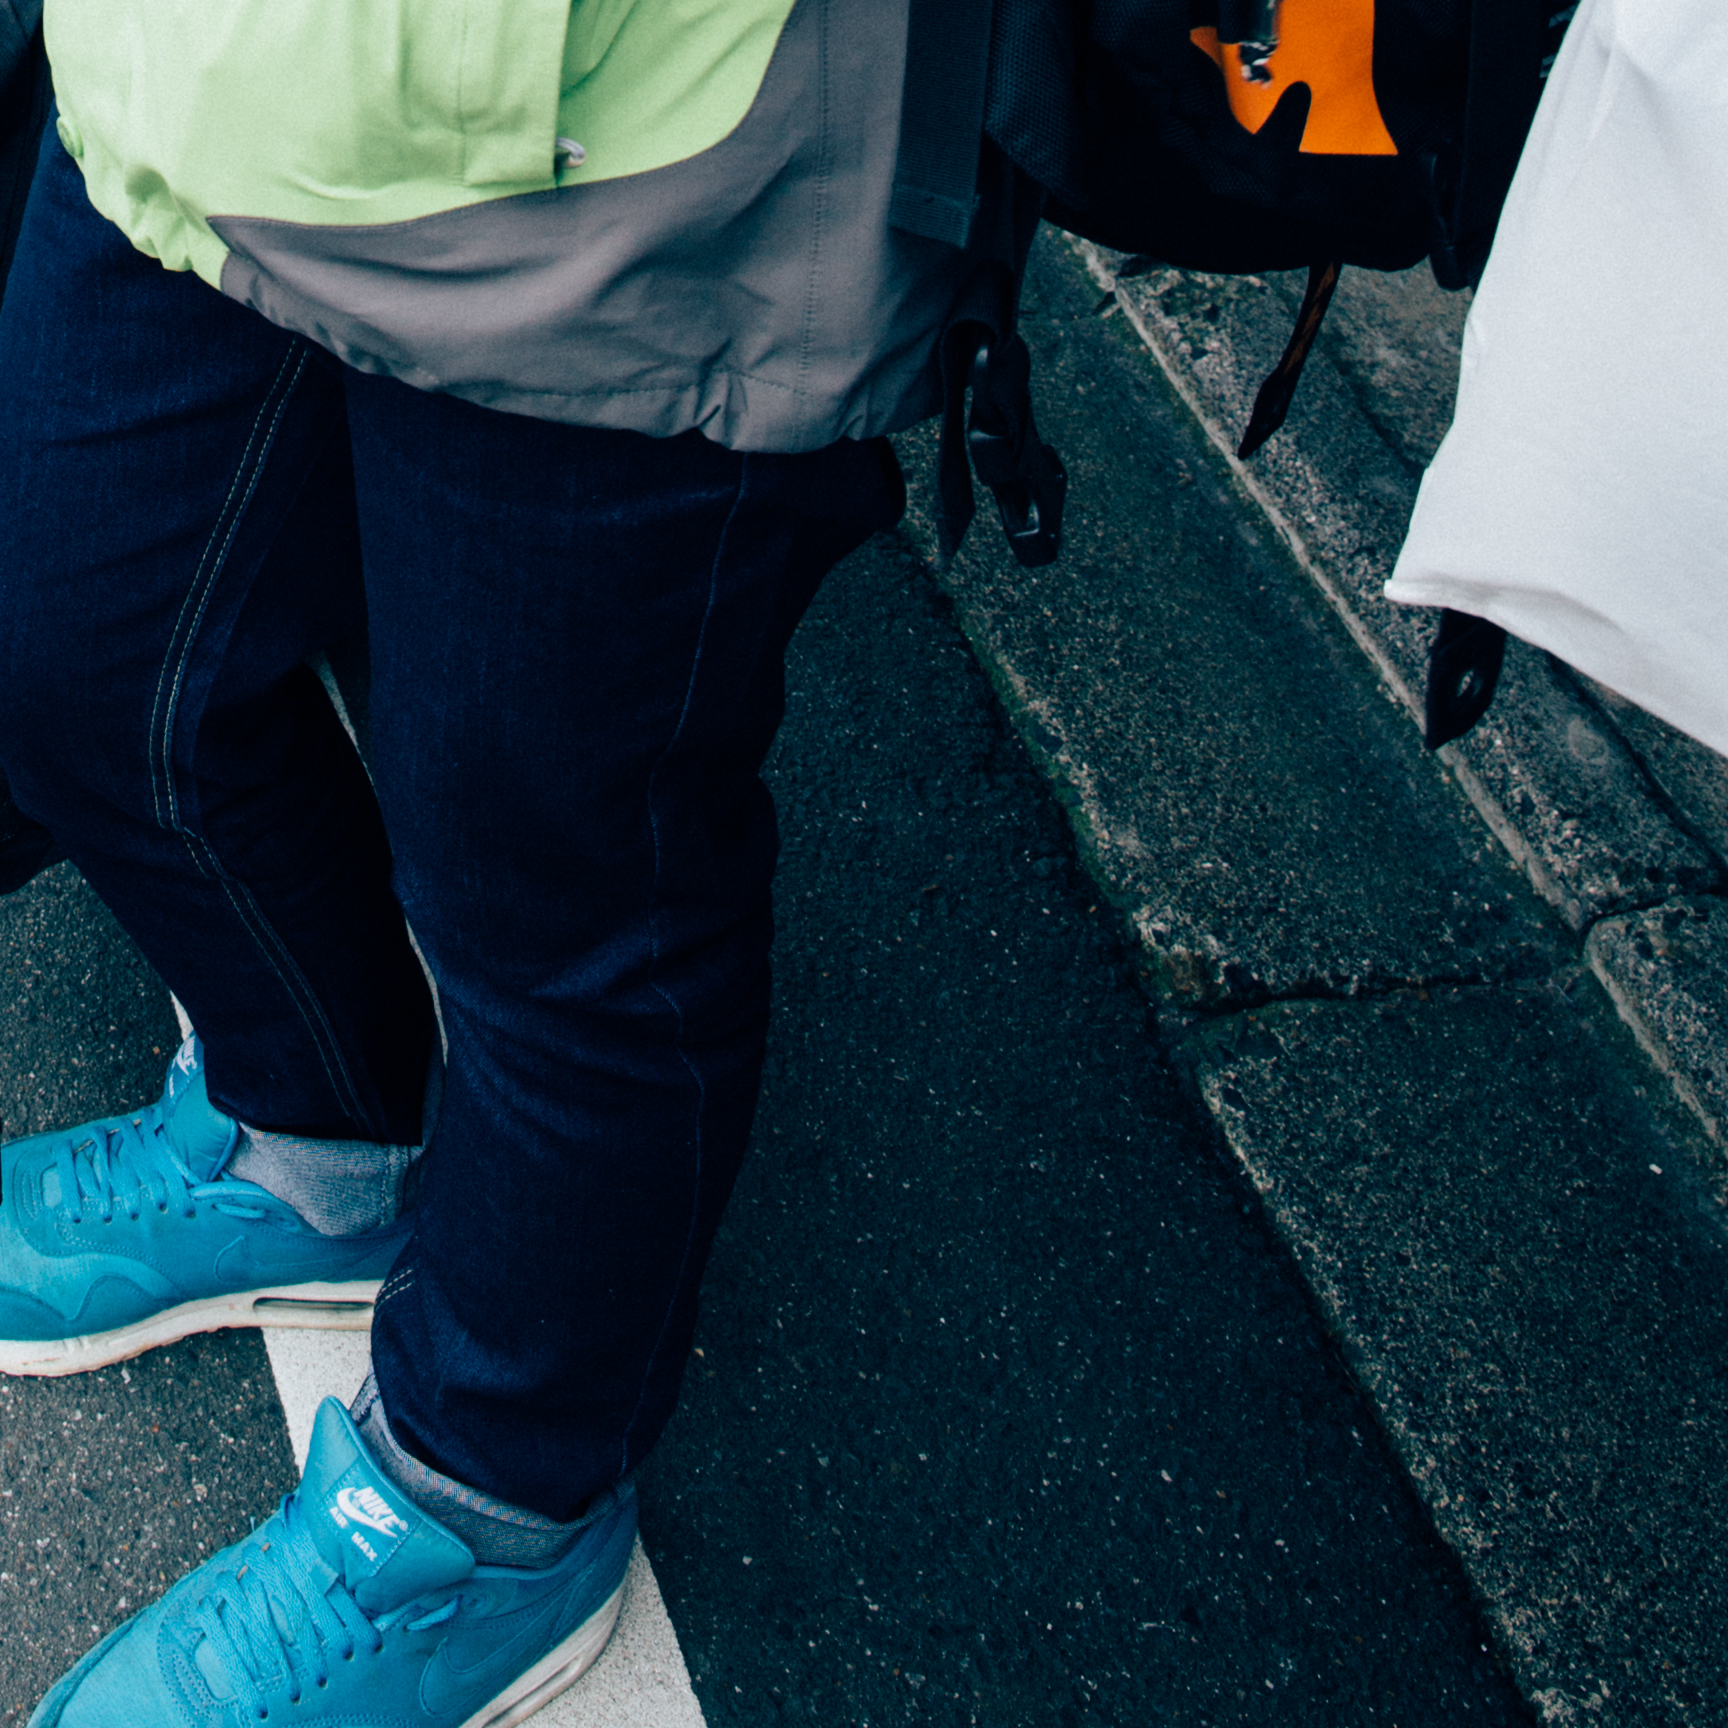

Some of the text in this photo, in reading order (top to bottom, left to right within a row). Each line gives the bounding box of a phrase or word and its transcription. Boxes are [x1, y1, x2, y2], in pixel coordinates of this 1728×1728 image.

[353, 1485, 401, 1529] NIKE
[329, 1505, 377, 1562] AIR MAX
